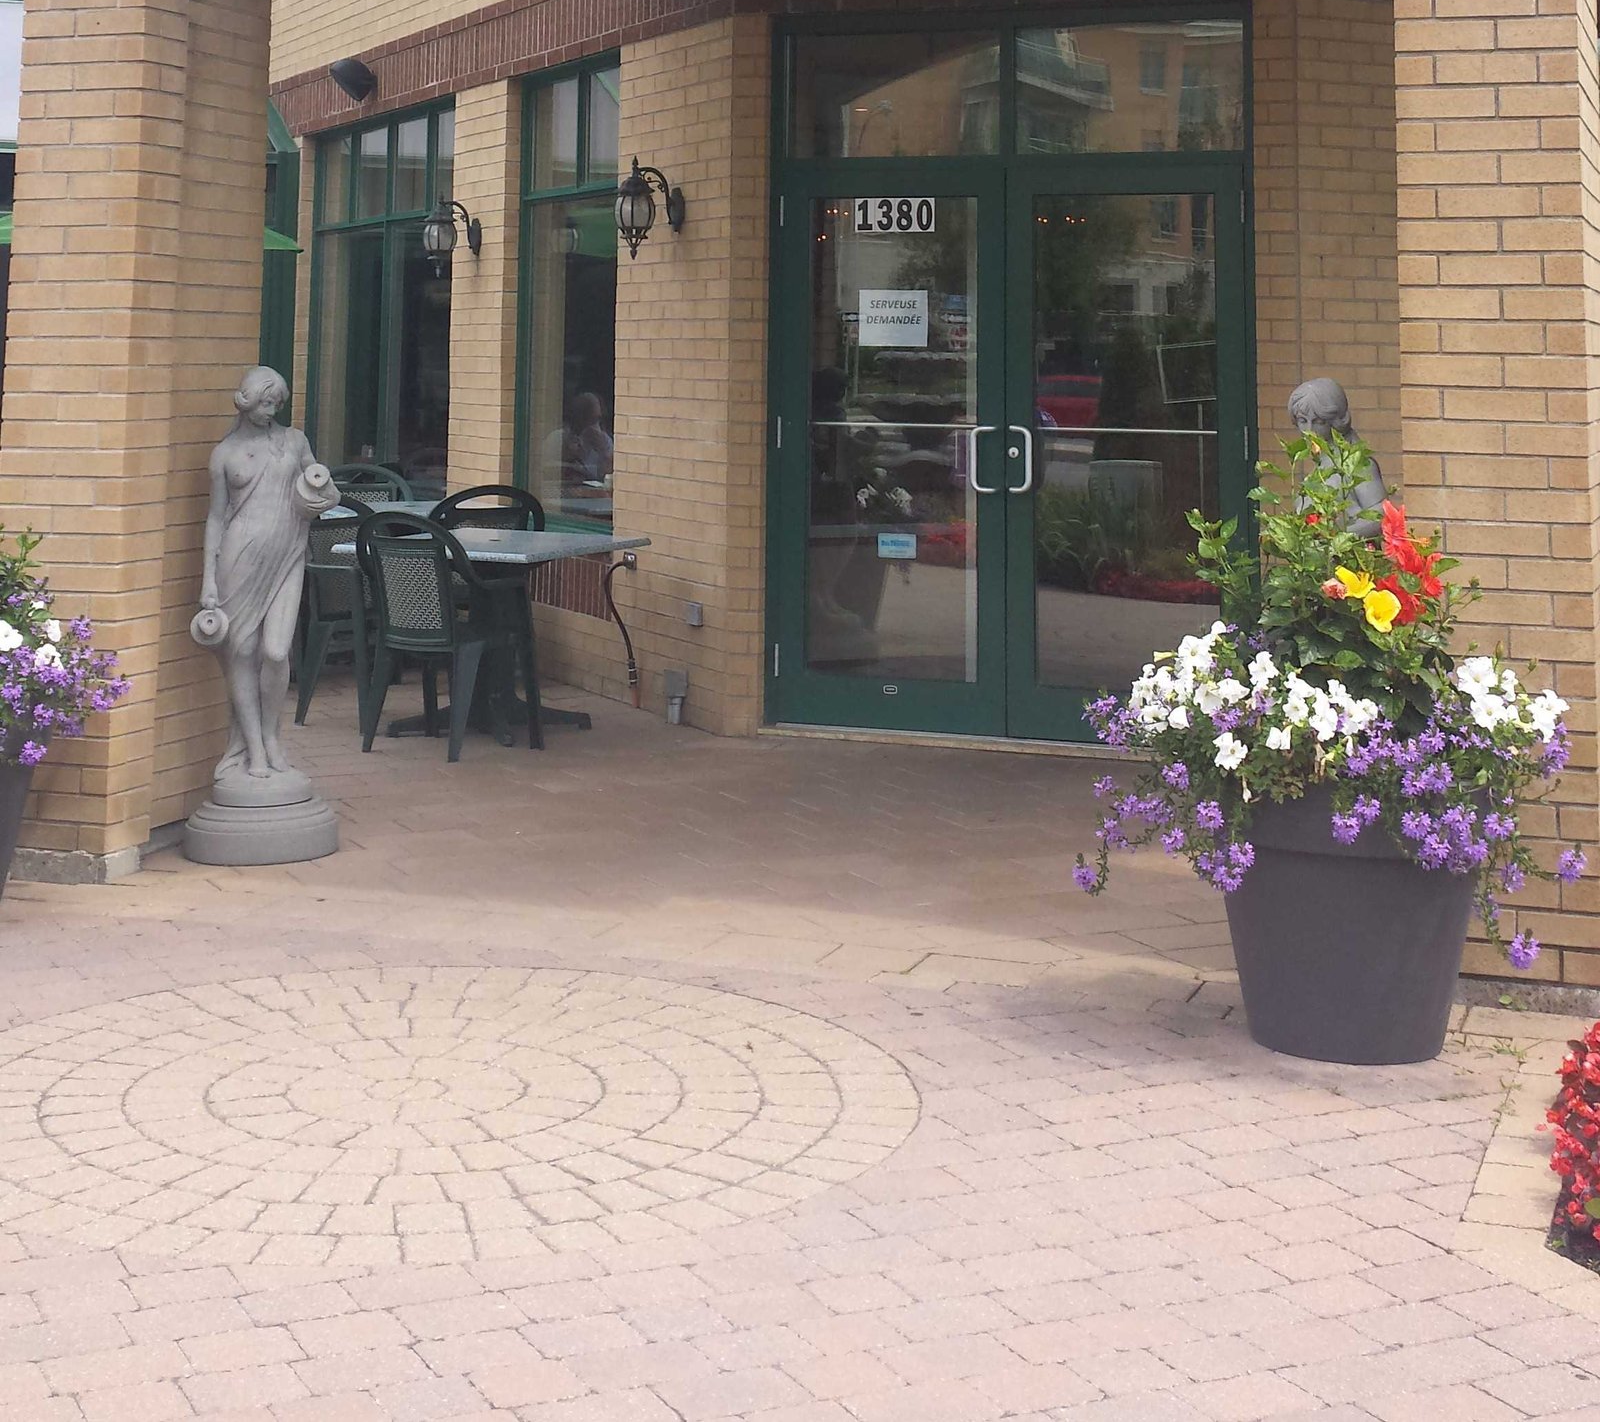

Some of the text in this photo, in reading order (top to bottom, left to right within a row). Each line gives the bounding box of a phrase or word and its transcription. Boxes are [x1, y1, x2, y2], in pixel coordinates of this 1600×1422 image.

[857, 199, 933, 231] 1380
[870, 299, 918, 309] SERVEUSE
[866, 314, 922, 325] DEMANDÉE
